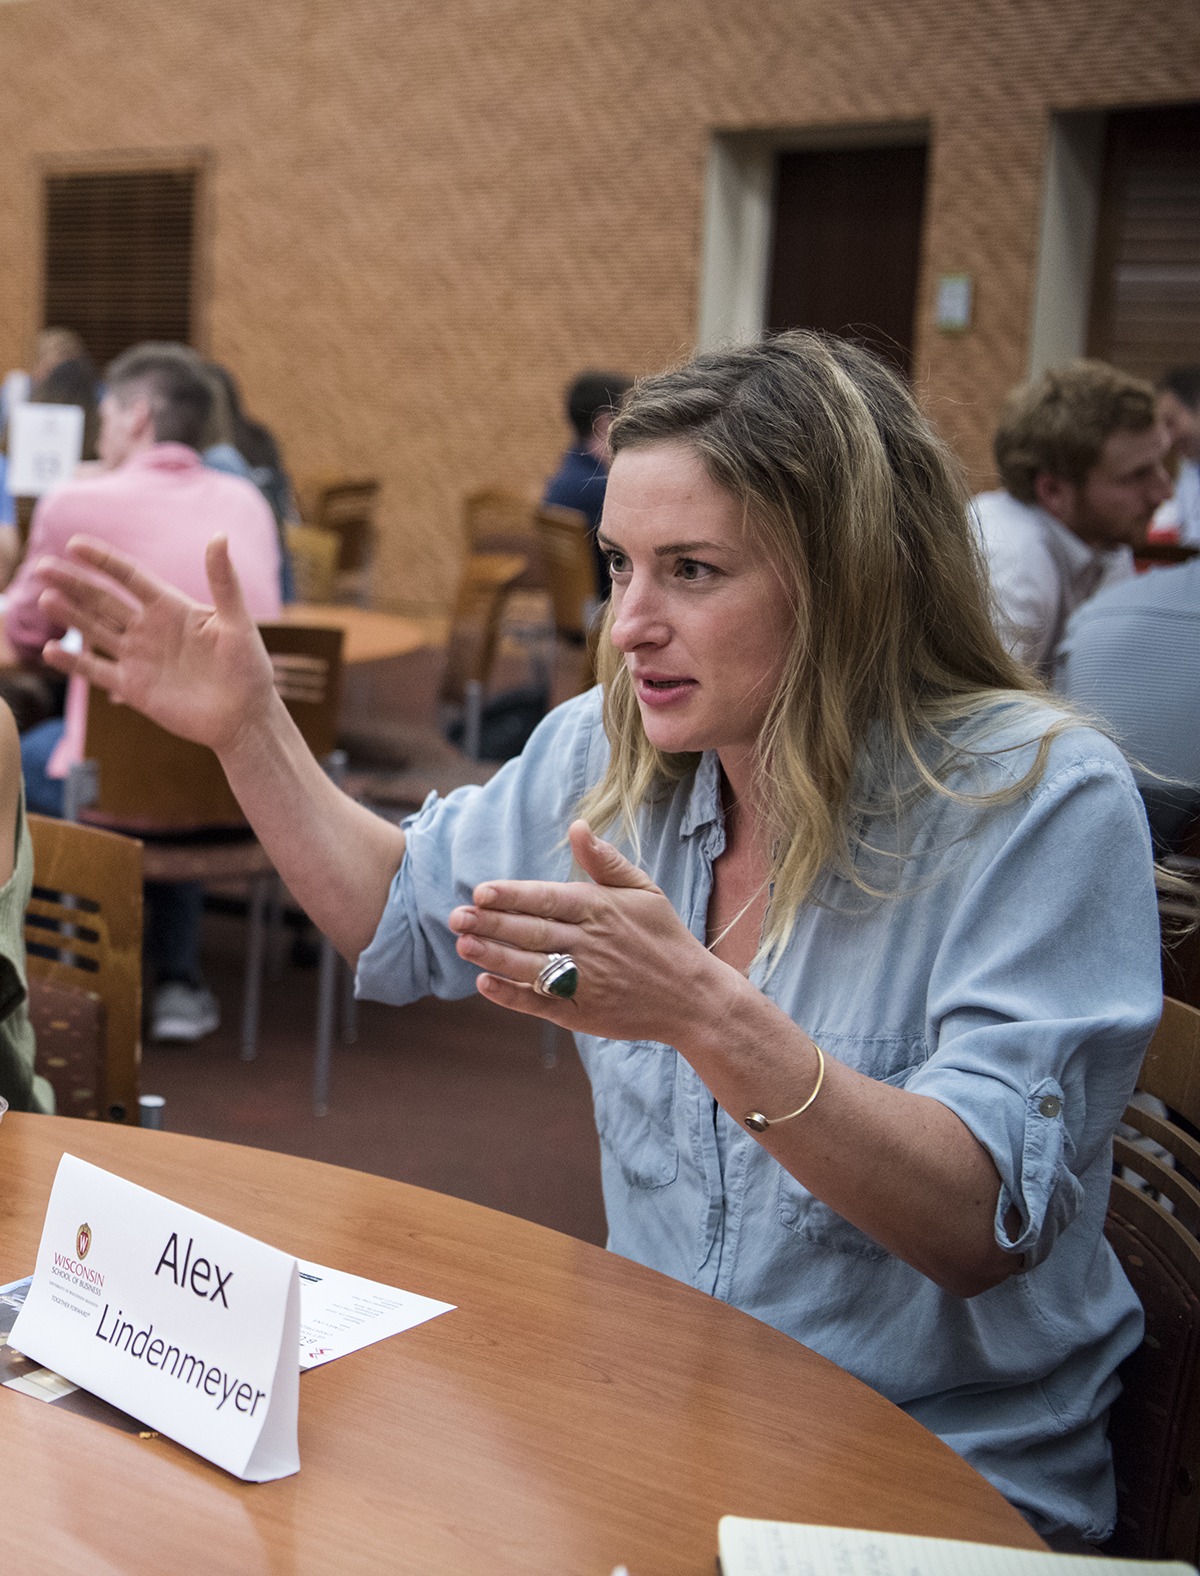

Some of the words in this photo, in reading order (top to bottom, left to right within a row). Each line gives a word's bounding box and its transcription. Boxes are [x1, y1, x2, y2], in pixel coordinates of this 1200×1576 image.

[52, 1266, 70, 1281] SCHOOL
[72, 1276, 80, 1285] OF
[79, 1280, 102, 1296] BUSINESS
[54, 1252, 104, 1287] WISCONSIN
[154, 1232, 234, 1310] Alex
[95, 1303, 266, 1417] Lindenmeyer
